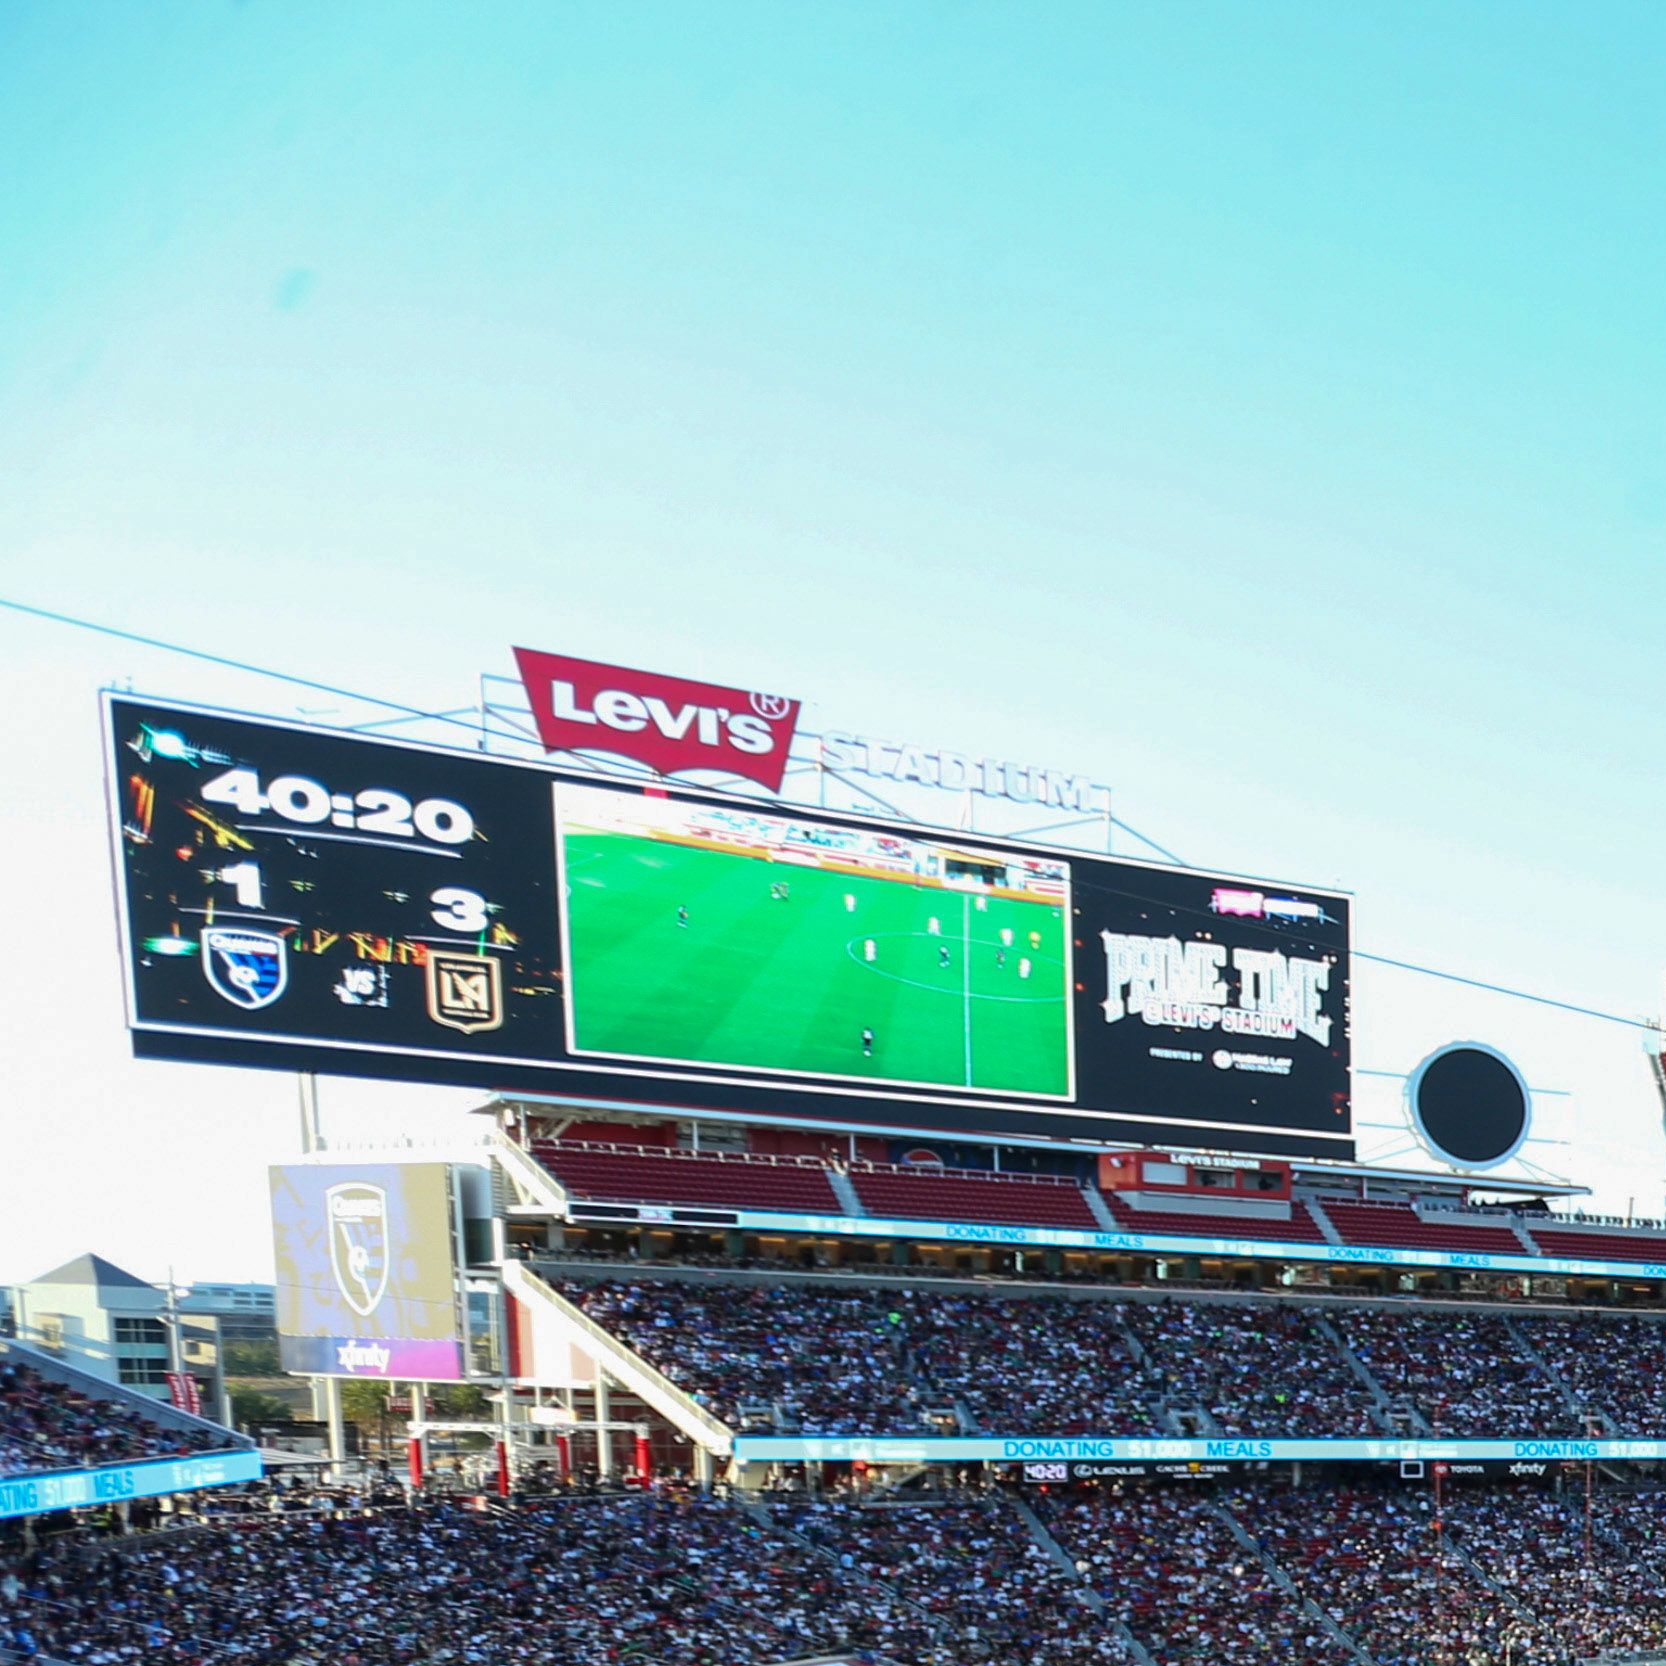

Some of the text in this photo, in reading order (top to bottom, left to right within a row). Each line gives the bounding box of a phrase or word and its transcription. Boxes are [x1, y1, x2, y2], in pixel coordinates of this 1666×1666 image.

[820, 729, 1092, 814] STADIUM
[201, 767, 474, 845] 40:20
[218, 861, 266, 910] 1
[430, 887, 489, 932] 3
[1101, 929, 1333, 1047] PRIME TIME
[1224, 1009, 1295, 1037] STADIUM
[946, 1225, 1026, 1240] DONATING
[1095, 1230, 1144, 1247] MEALS
[1328, 1248, 1490, 1265] DONATING MEALS
[1003, 1441, 1113, 1458] DONATING
[1206, 1442, 1272, 1457] MEALS
[1514, 1443, 1598, 1457] DONATING
[1450, 1465, 1484, 1474] TOYOTA
[1509, 1462, 1546, 1476] xfinity
